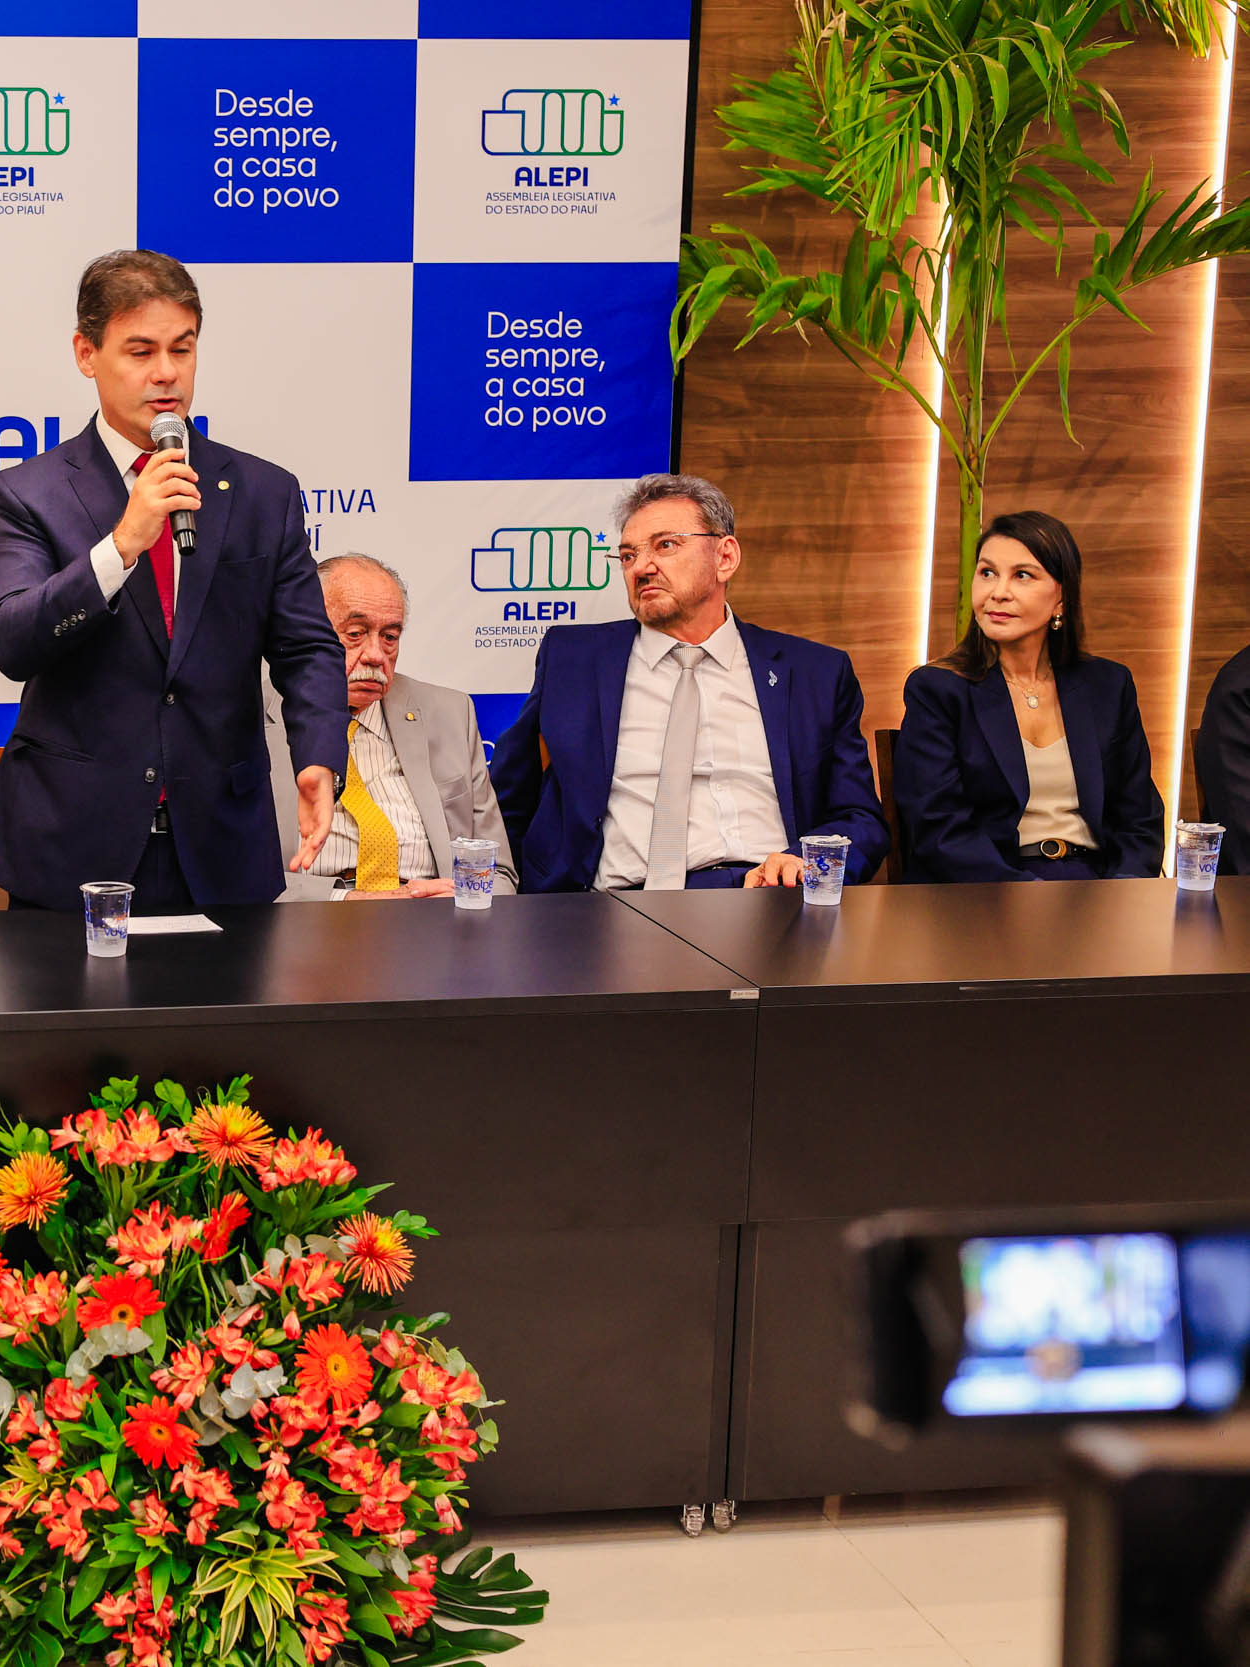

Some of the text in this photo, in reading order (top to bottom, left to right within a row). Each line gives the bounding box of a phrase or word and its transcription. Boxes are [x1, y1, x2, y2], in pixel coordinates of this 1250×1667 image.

[215, 88, 314, 117] Desde
[213, 127, 338, 154] sempre,
[214, 157, 317, 178] a casa
[514, 166, 589, 188] ALEPI
[213, 180, 340, 214] do povo
[485, 191, 617, 202] ASSEMBLEIA LEGISLATIVA
[16, 203, 46, 215] PIAUÍ
[485, 203, 599, 215] DO ESTADO DO PIAUÍ
[487, 310, 583, 339] Desde
[485, 347, 606, 374] sempre,
[485, 377, 585, 398] a casa
[484, 399, 607, 433] do povo
[503, 601, 576, 622] ALEPI
[475, 626, 539, 636] ASSEMBLEIA
[475, 638, 492, 648] DO
[494, 638, 537, 648] ESTADO
